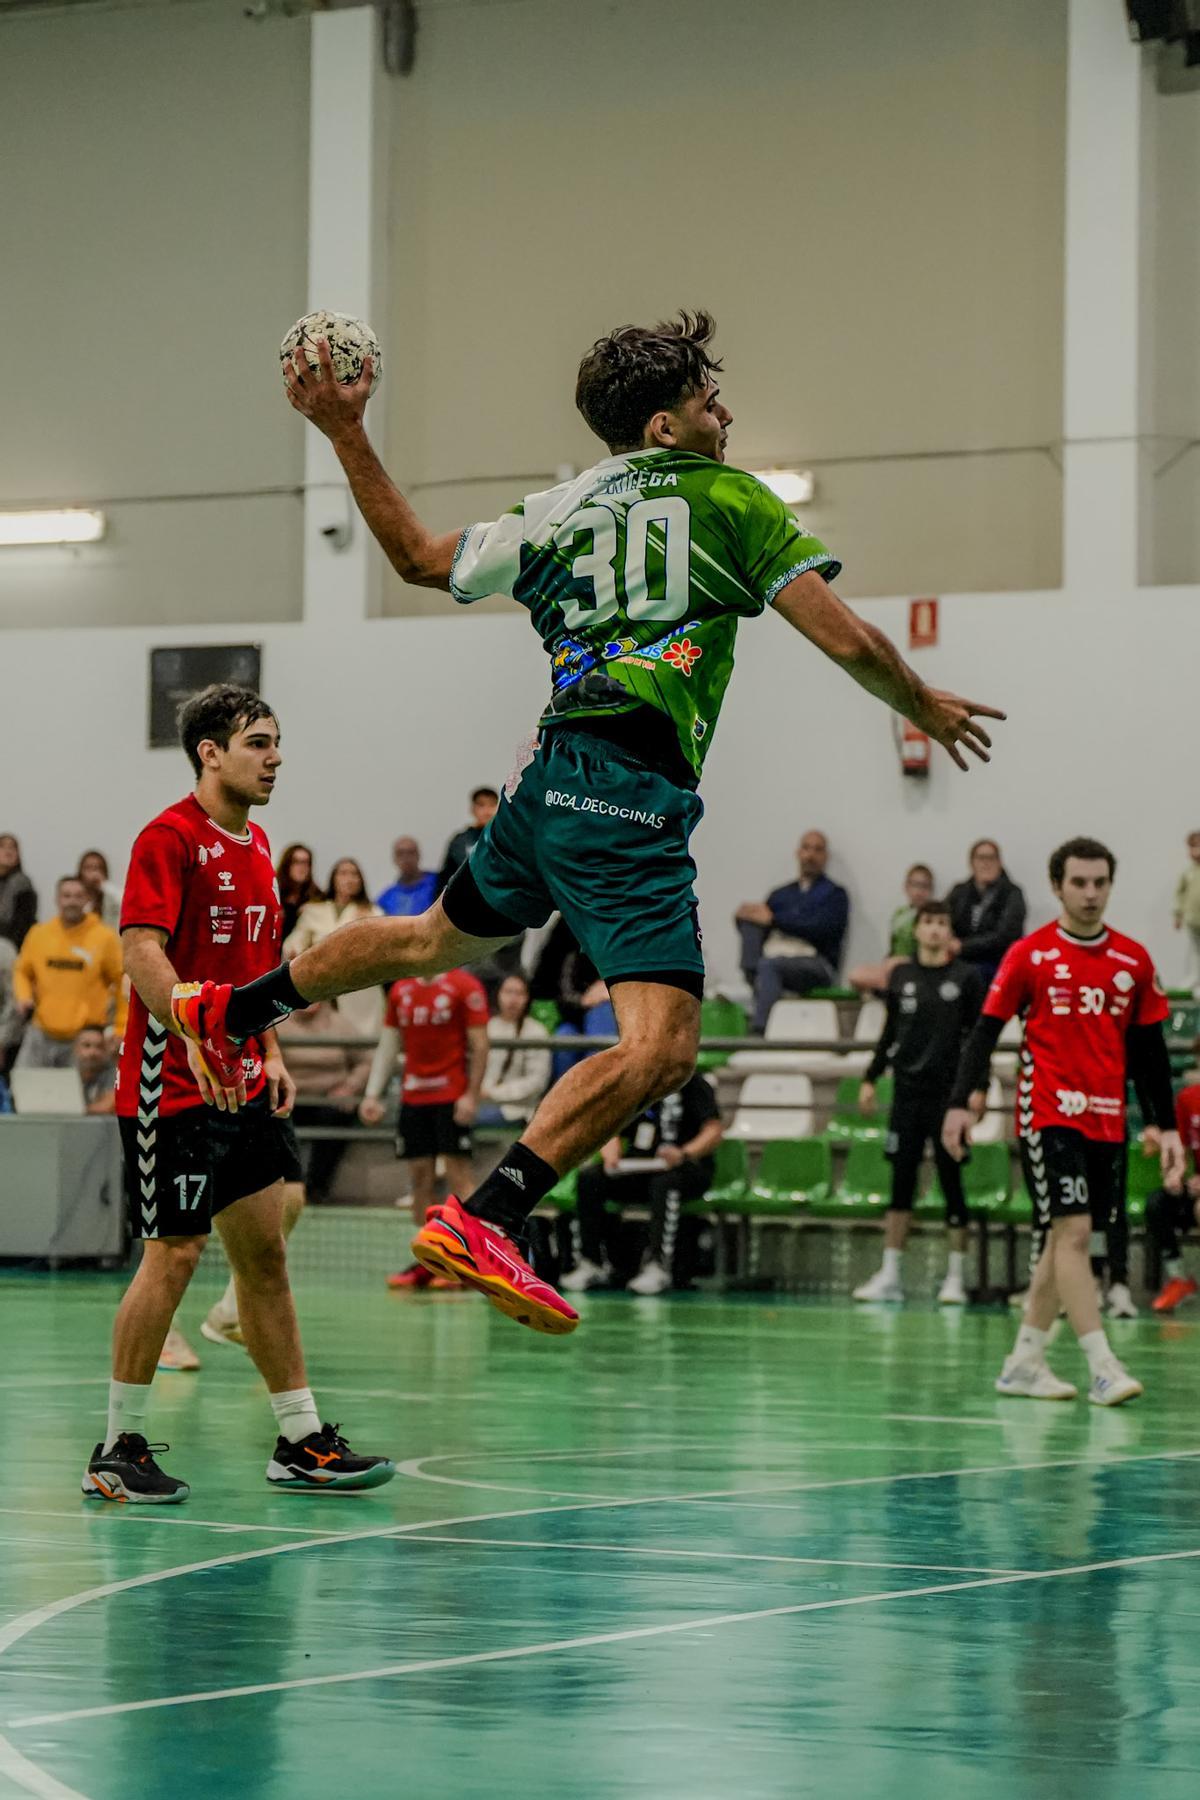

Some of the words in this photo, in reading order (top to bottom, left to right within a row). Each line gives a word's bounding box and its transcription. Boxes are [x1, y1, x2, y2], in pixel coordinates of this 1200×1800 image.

[553, 495, 691, 630] 30
[545, 789, 666, 829] @DCA_DECOCINAS
[245, 905, 267, 942] 17
[1078, 986, 1106, 1016] 30
[173, 1174, 208, 1211] 17
[1059, 1175, 1090, 1206] 30
